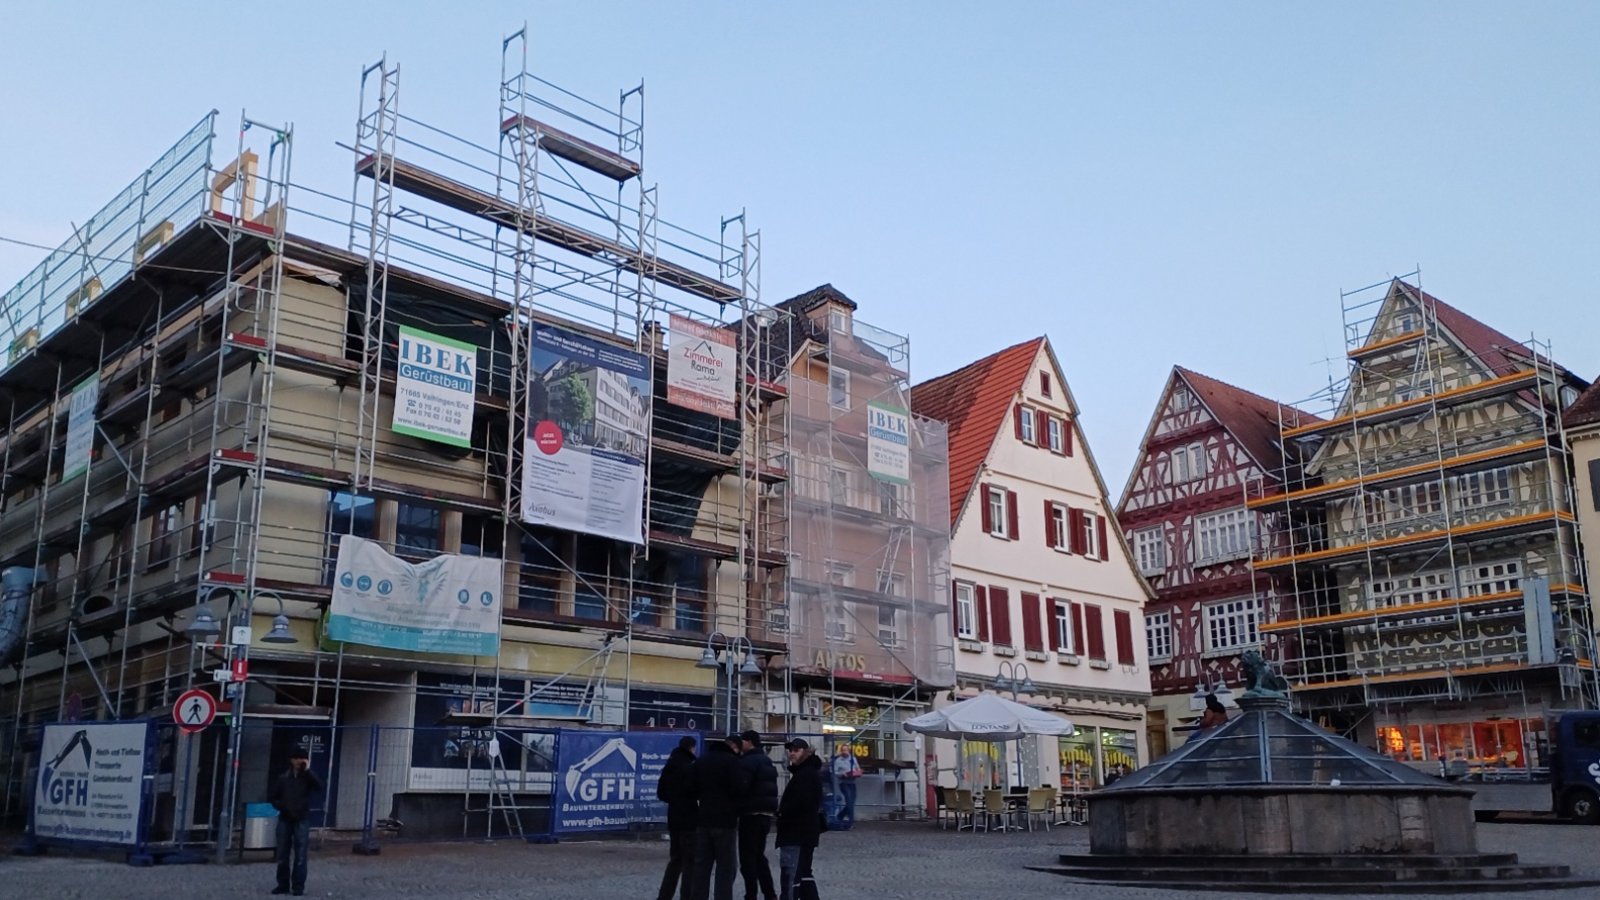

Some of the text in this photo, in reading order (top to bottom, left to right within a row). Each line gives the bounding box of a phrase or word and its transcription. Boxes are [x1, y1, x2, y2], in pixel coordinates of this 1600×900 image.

[401, 339, 473, 377] IBEK
[683, 346, 723, 369] Zimmerei
[690, 359, 715, 376] Rama
[406, 407, 417, 415] Fax
[869, 409, 907, 434] IBEK
[641, 752, 660, 760] Hoch-
[50, 778, 88, 806] GFH
[580, 778, 636, 801] GFH
